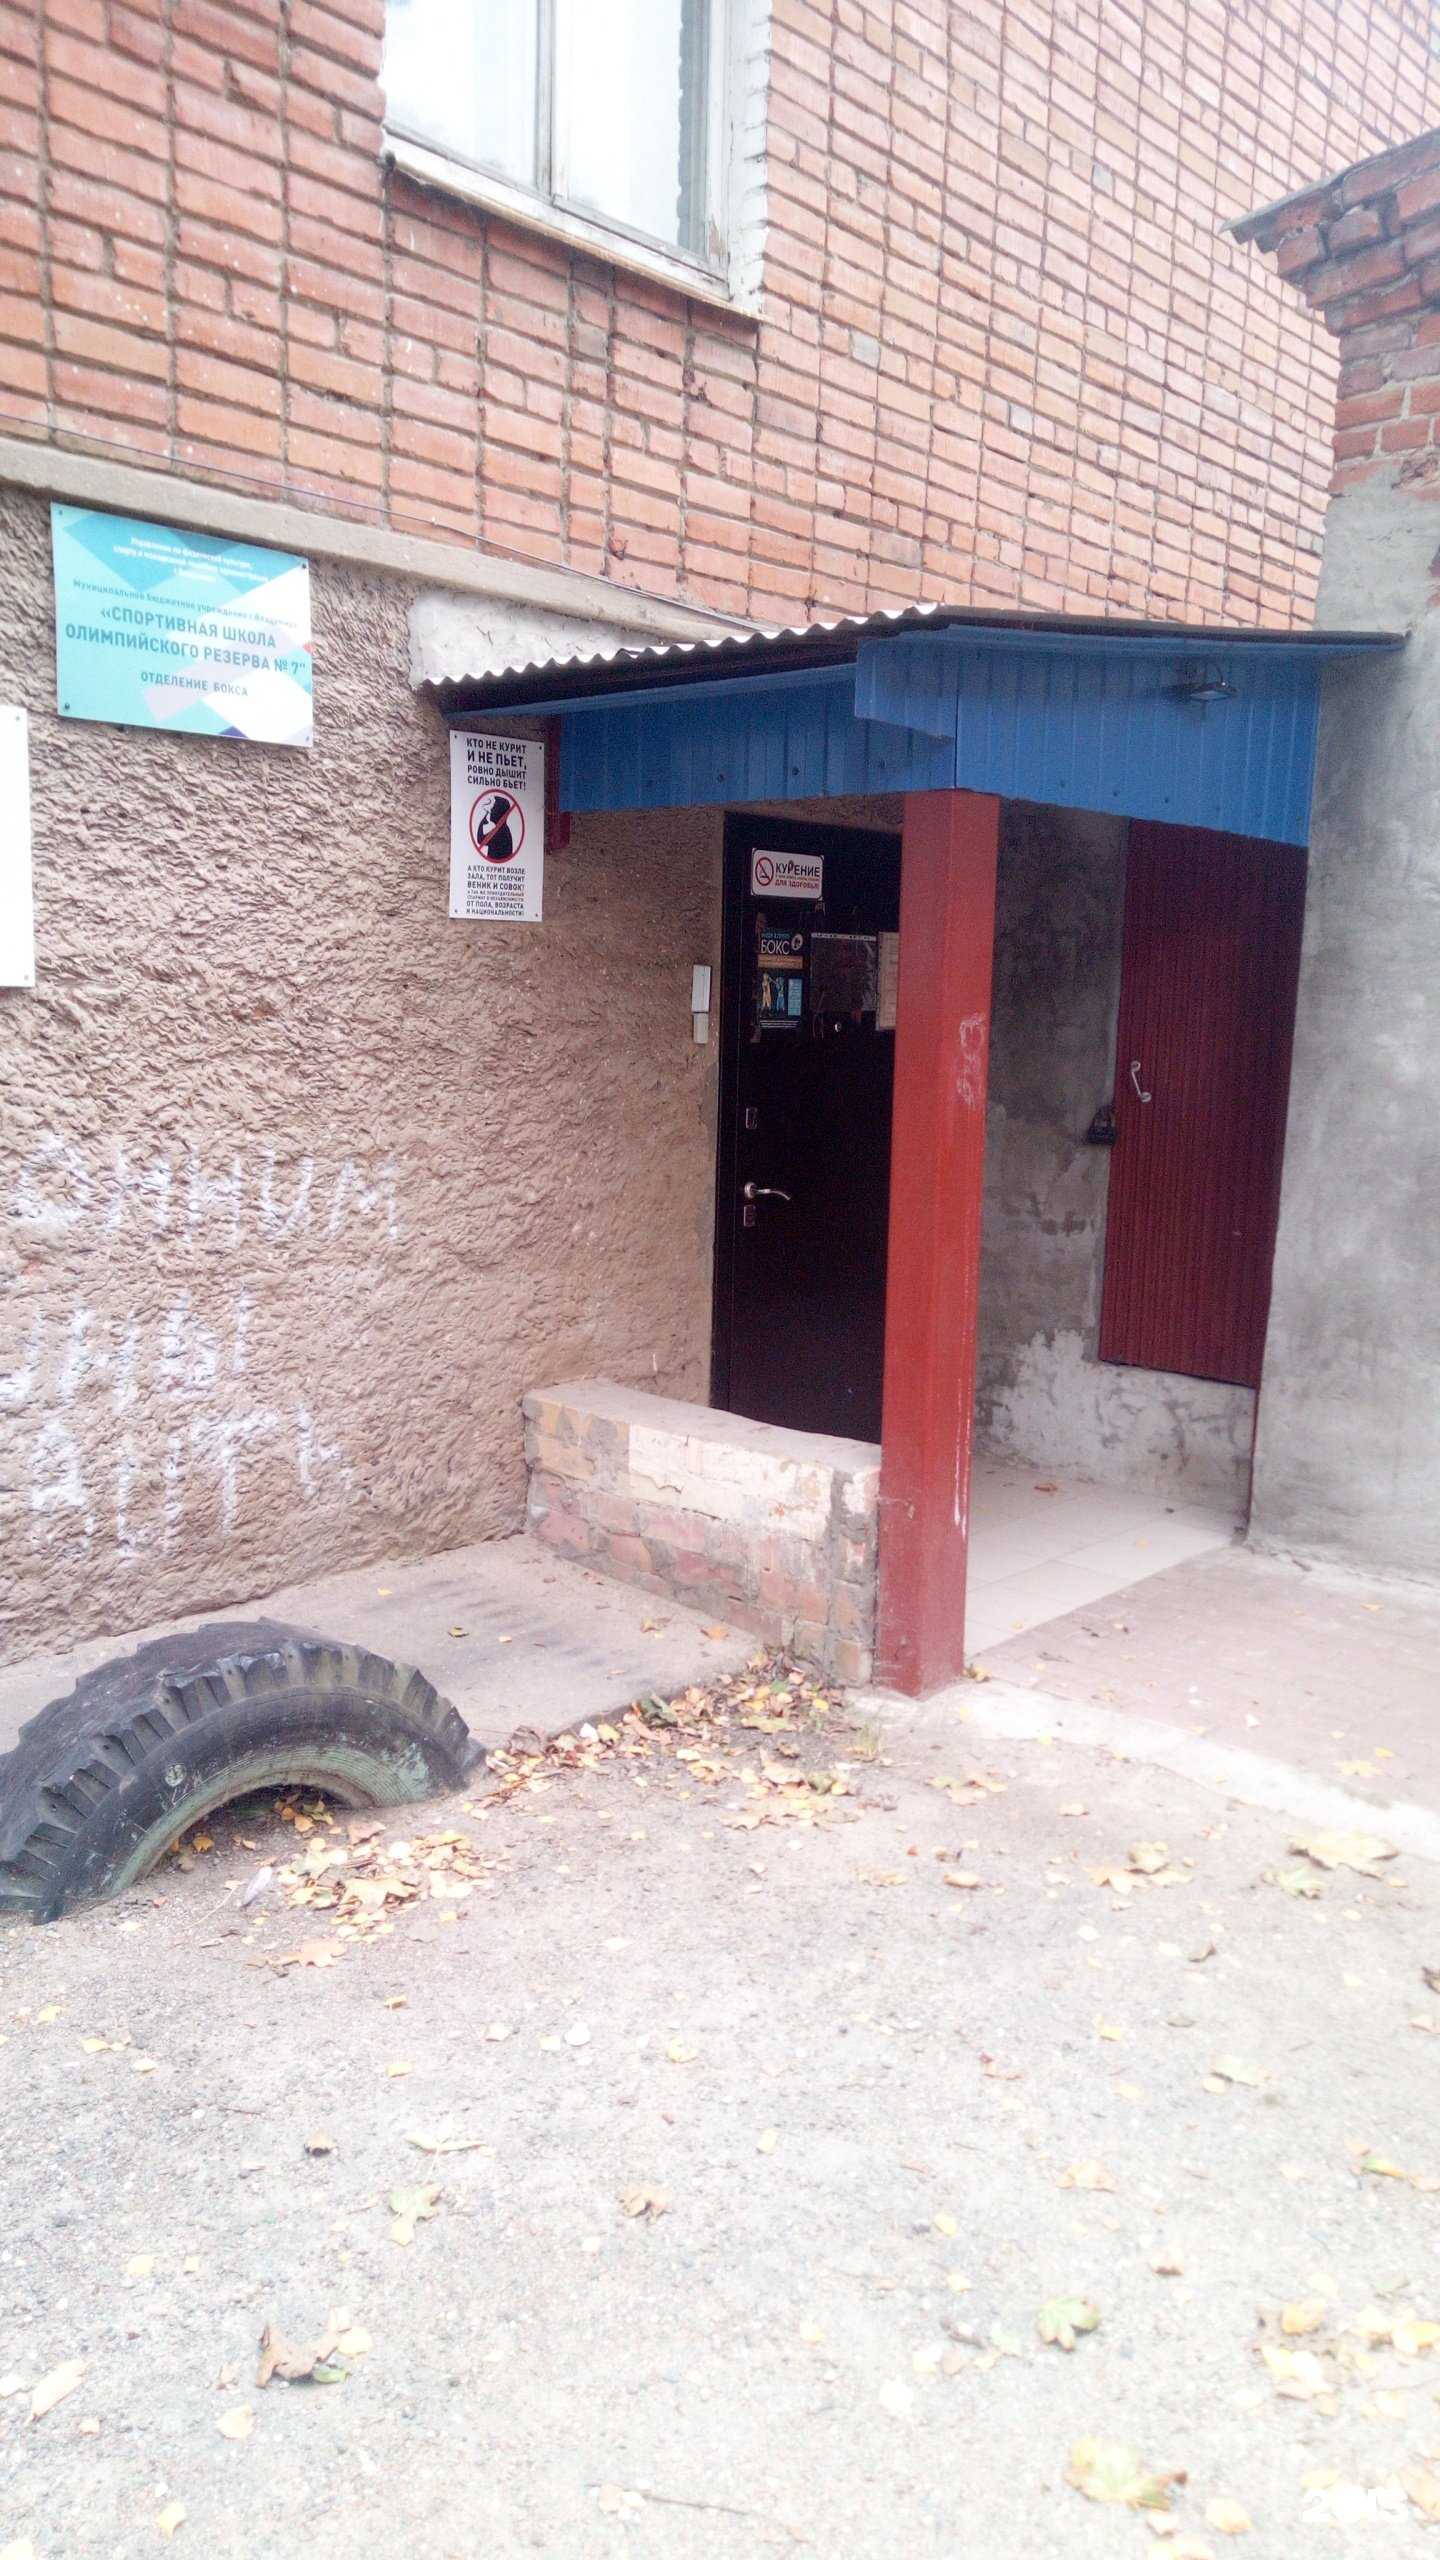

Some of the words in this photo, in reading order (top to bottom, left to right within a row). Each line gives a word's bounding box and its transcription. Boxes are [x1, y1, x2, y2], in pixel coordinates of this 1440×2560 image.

[100, 605, 217, 637] «СПОРТИВНАЯ
[223, 626, 276, 649] ШКОЛА
[65, 623, 199, 659] ОЛИМПИЙСКОГО
[204, 647, 270, 670] РЕЗЕРВА
[140, 671, 208, 691] ОТДЕЛЕНИЕ
[213, 682, 248, 696] БОКСА
[466, 737, 484, 749] КТО
[486, 740, 497, 750] НЕ
[499, 742, 527, 754] КУРИТ
[467, 750, 475, 762] И
[479, 751, 493, 764] НЕ
[496, 753, 527, 770] ПЬЕТ,
[467, 765, 494, 776] РОВНО
[495, 768, 527, 780] ДЫШИТ
[467, 775, 501, 787] СИЛЬНО
[503, 779, 526, 792] БЬЕТ!
[506, 867, 525, 875] ВОЗЛЕ
[775, 860, 820, 877] КУРЕНИЕ
[467, 881, 491, 889] ВЕНИК
[493, 882, 498, 890] И
[499, 883, 525, 891] СОВОК!
[498, 875, 525, 883] ПОЛУЧИТ
[775, 879, 787, 887] ДЛЯ
[760, 939, 790, 955] БОКС
